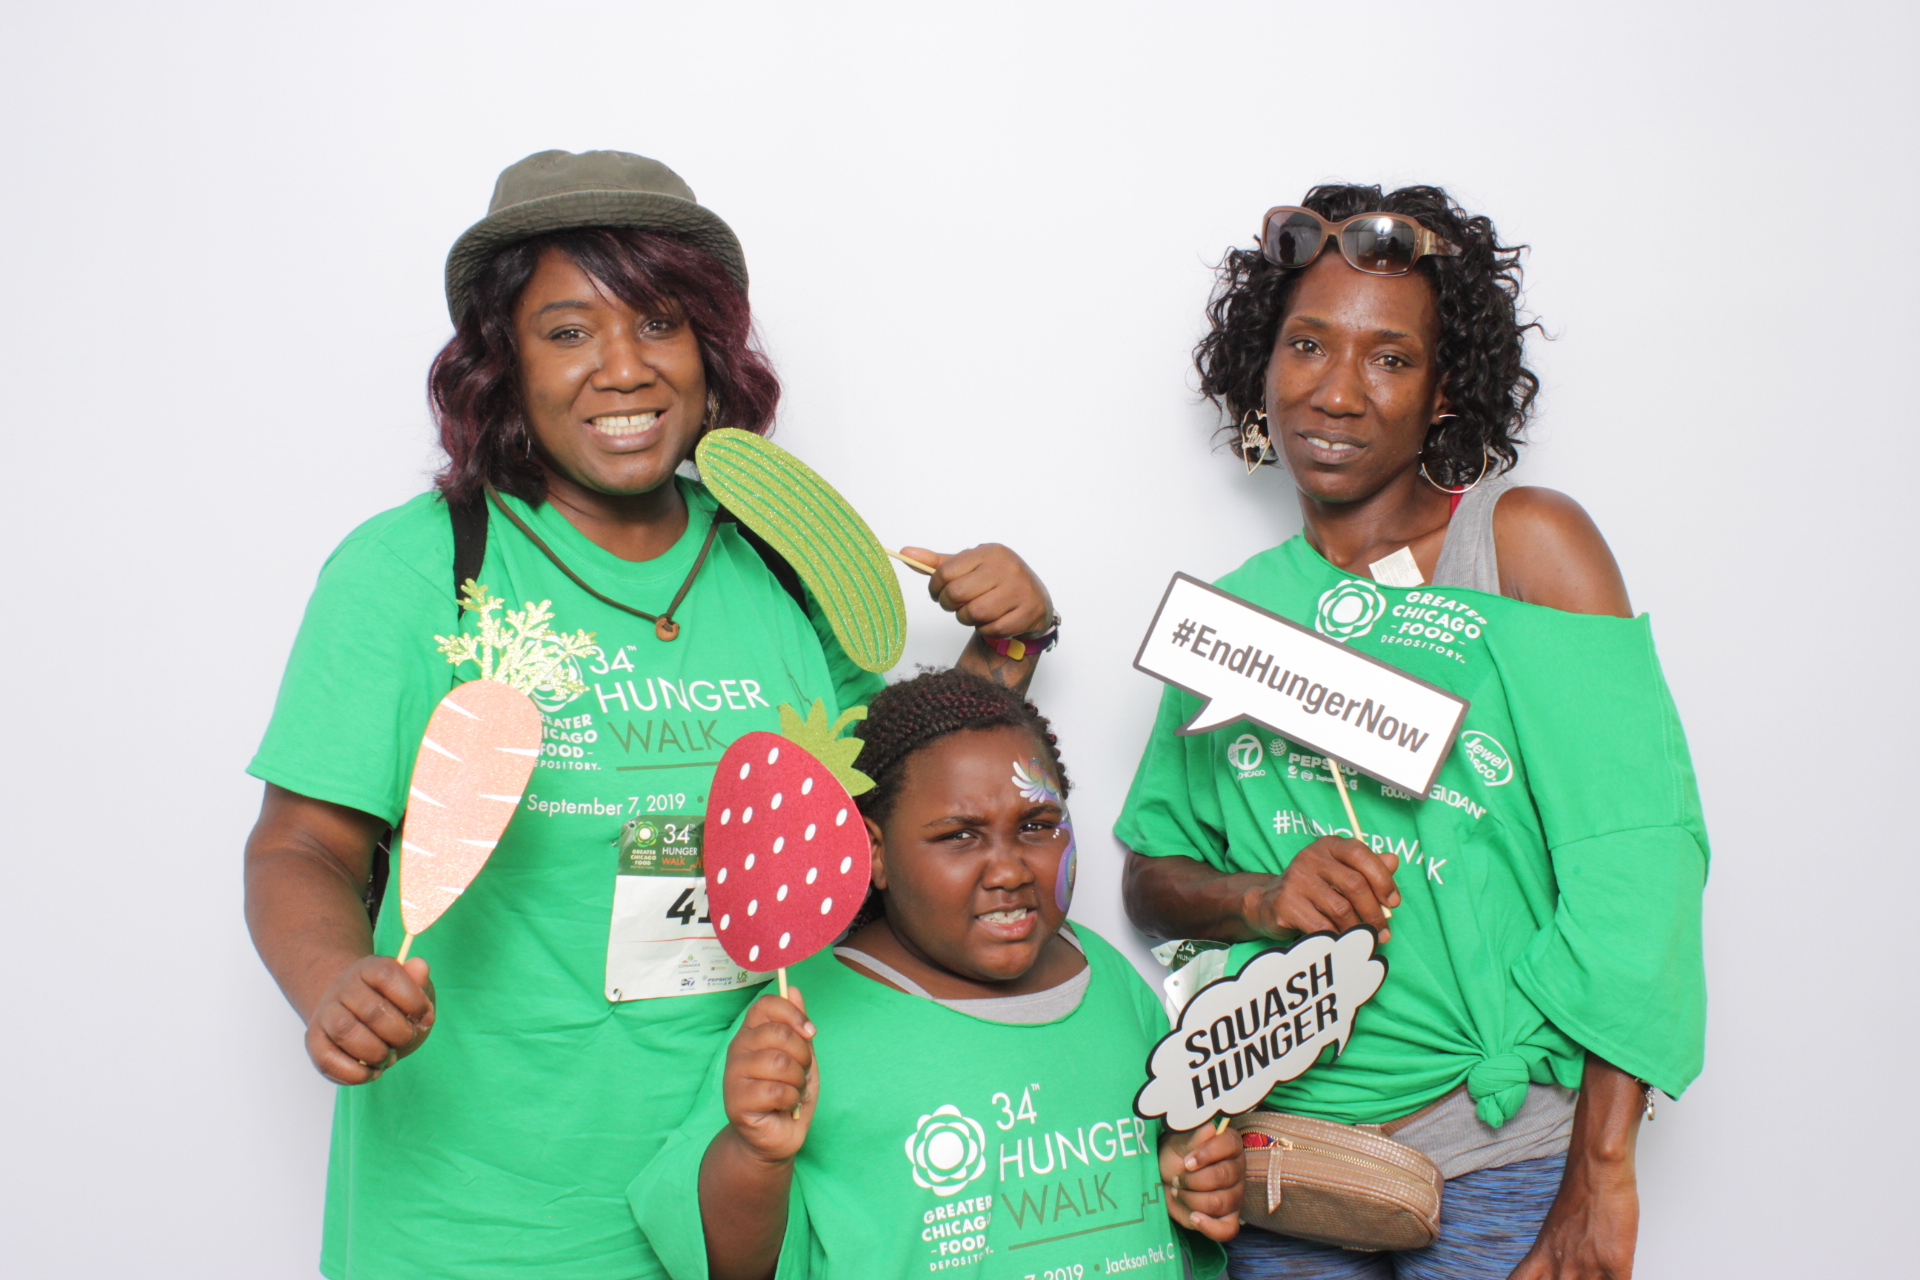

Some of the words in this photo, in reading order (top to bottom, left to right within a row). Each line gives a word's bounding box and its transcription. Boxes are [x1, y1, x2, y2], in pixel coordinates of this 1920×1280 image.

[1392, 604, 1481, 639] CHICAGO
[1405, 591, 1488, 625] GREATER
[594, 676, 770, 713] HUNGER
[1171, 617, 1430, 754] #EndHungerNow
[539, 711, 593, 730] REATER
[543, 726, 598, 744] ICAGO
[607, 719, 728, 754] WALK
[534, 759, 598, 771] EPOSITORY
[1288, 752, 1359, 776] PEPSCO
[1464, 737, 1508, 770] Jewel
[527, 794, 622, 817] September
[646, 793, 686, 812] 2019
[661, 857, 686, 866] WALK
[662, 847, 698, 856] HUNGER
[1185, 953, 1334, 1069] SQUASH
[1191, 992, 1338, 1109] HUNGER
[1000, 1116, 1150, 1182] HUNGER
[923, 1194, 993, 1225] GREATER
[1001, 1172, 1118, 1230] WALK
[1105, 1252, 1149, 1275] Jackson
